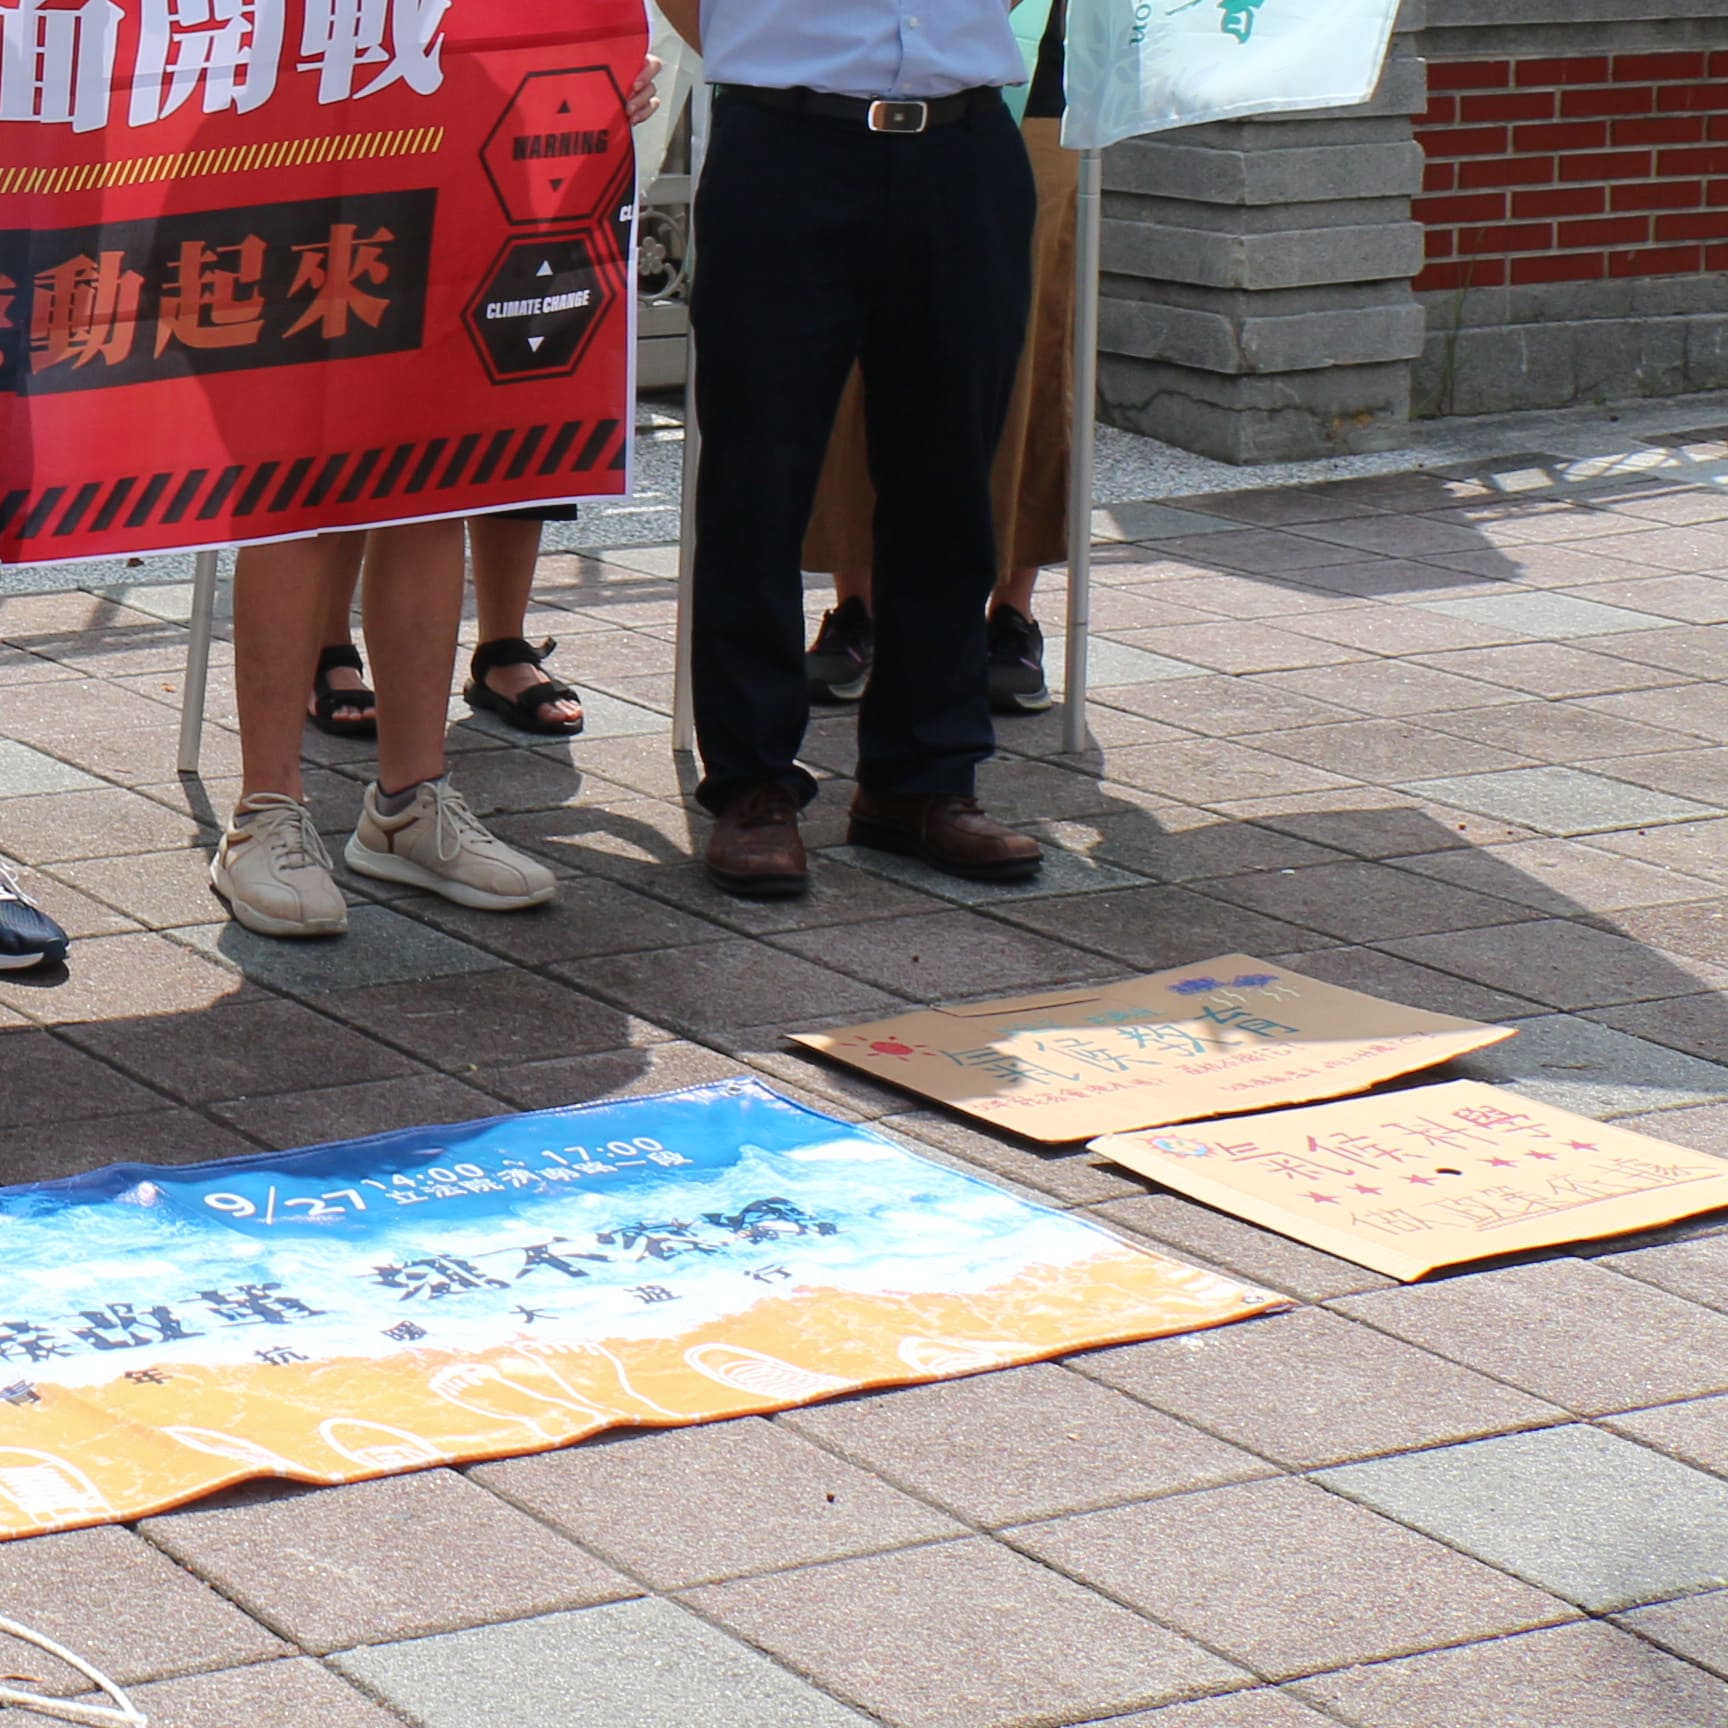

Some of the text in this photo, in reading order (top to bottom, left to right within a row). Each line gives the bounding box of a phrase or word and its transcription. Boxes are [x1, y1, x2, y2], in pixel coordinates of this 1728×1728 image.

[511, 129, 609, 161] WARNING
[485, 288, 592, 320] CLIMATE CHANGE
[943, 1003, 1302, 1086] 氣候教育
[203, 1183, 367, 1226] 9/27
[360, 1160, 486, 1192] 14:00
[541, 1134, 665, 1167] 17:00
[1214, 1102, 1552, 1184] 氣候科學
